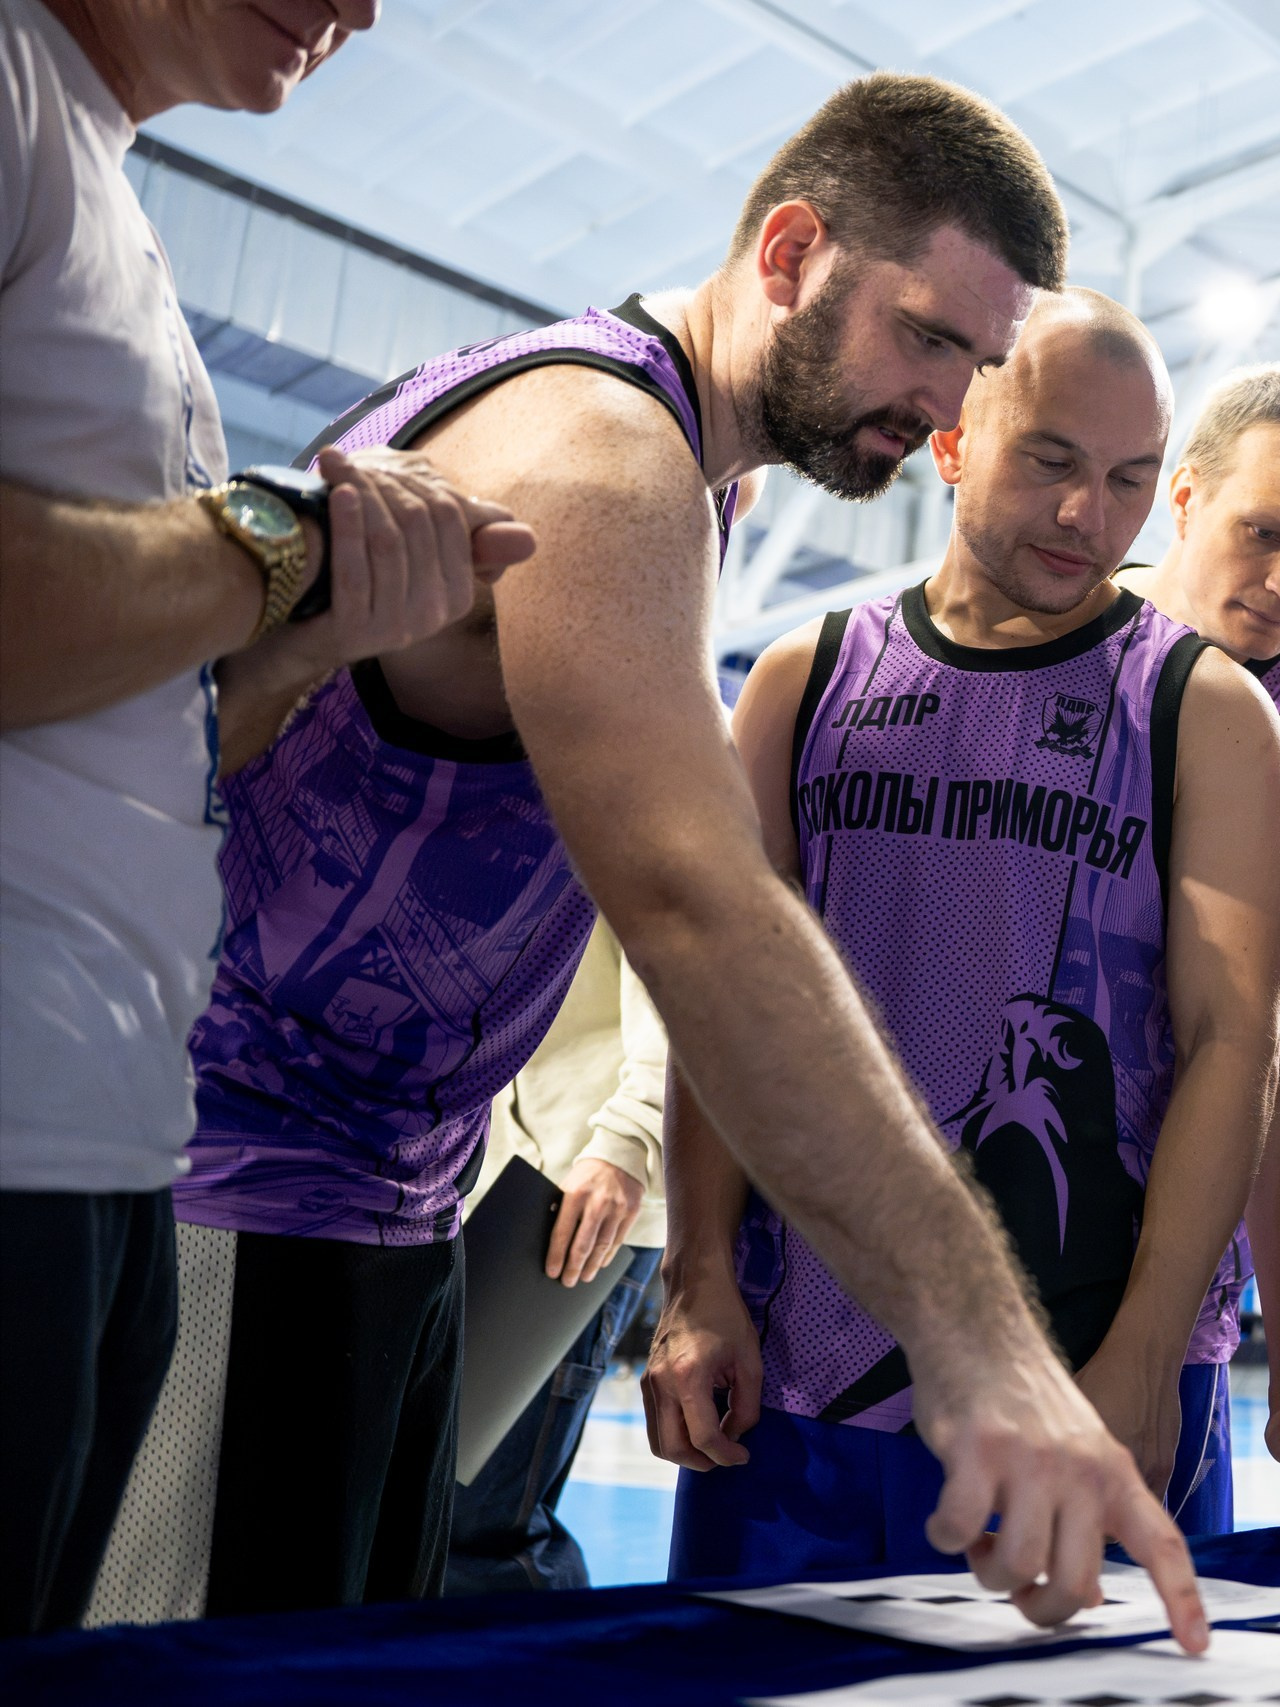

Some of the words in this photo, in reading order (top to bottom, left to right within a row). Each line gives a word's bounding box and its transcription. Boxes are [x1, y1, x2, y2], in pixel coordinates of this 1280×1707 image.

[831, 693, 942, 732] ЛДПР
[1055, 695, 1096, 715] ЛДПР
[799, 771, 940, 842] СОКОЛЫ
[941, 778, 1148, 880] ПРИМОРЬЯ
